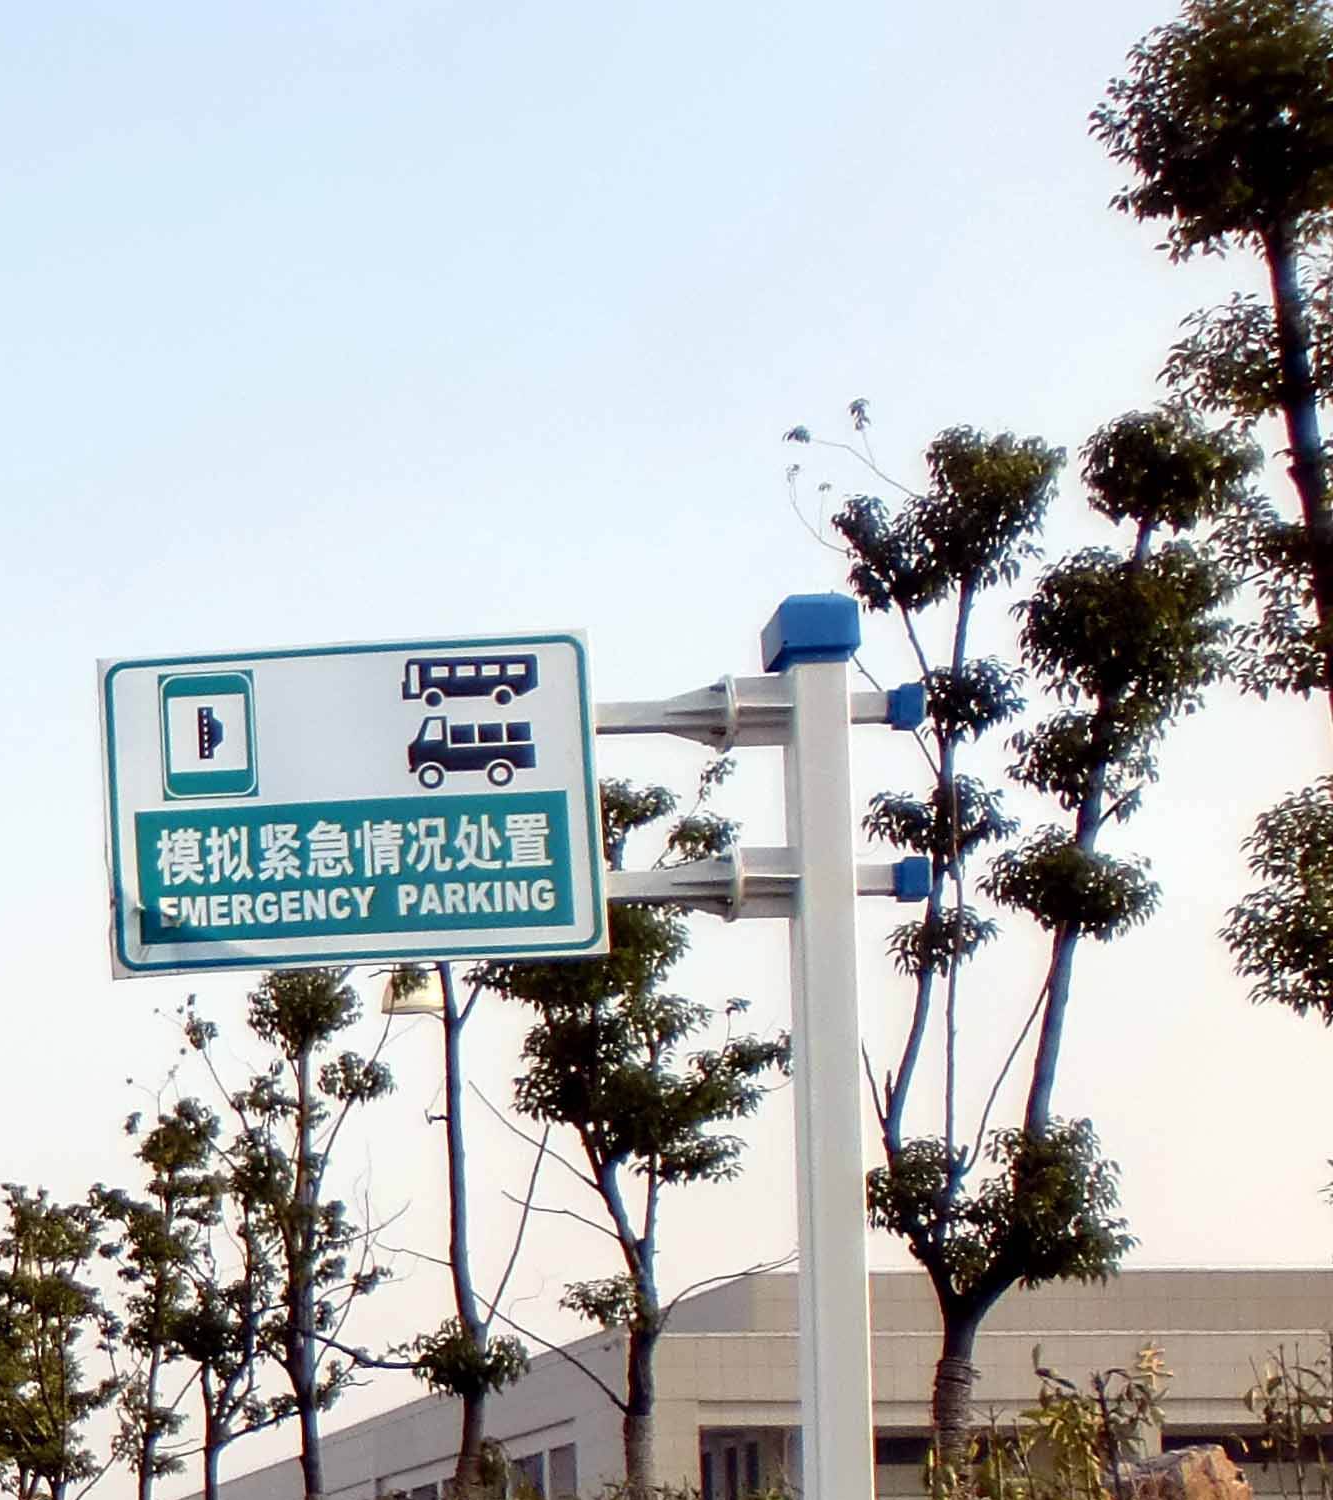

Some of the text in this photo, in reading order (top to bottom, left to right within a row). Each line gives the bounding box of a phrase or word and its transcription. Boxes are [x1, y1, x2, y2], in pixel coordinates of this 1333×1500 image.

[157, 813, 553, 886] 模拟紧急情况处置
[159, 879, 556, 928] EMERGENCY PARKING
